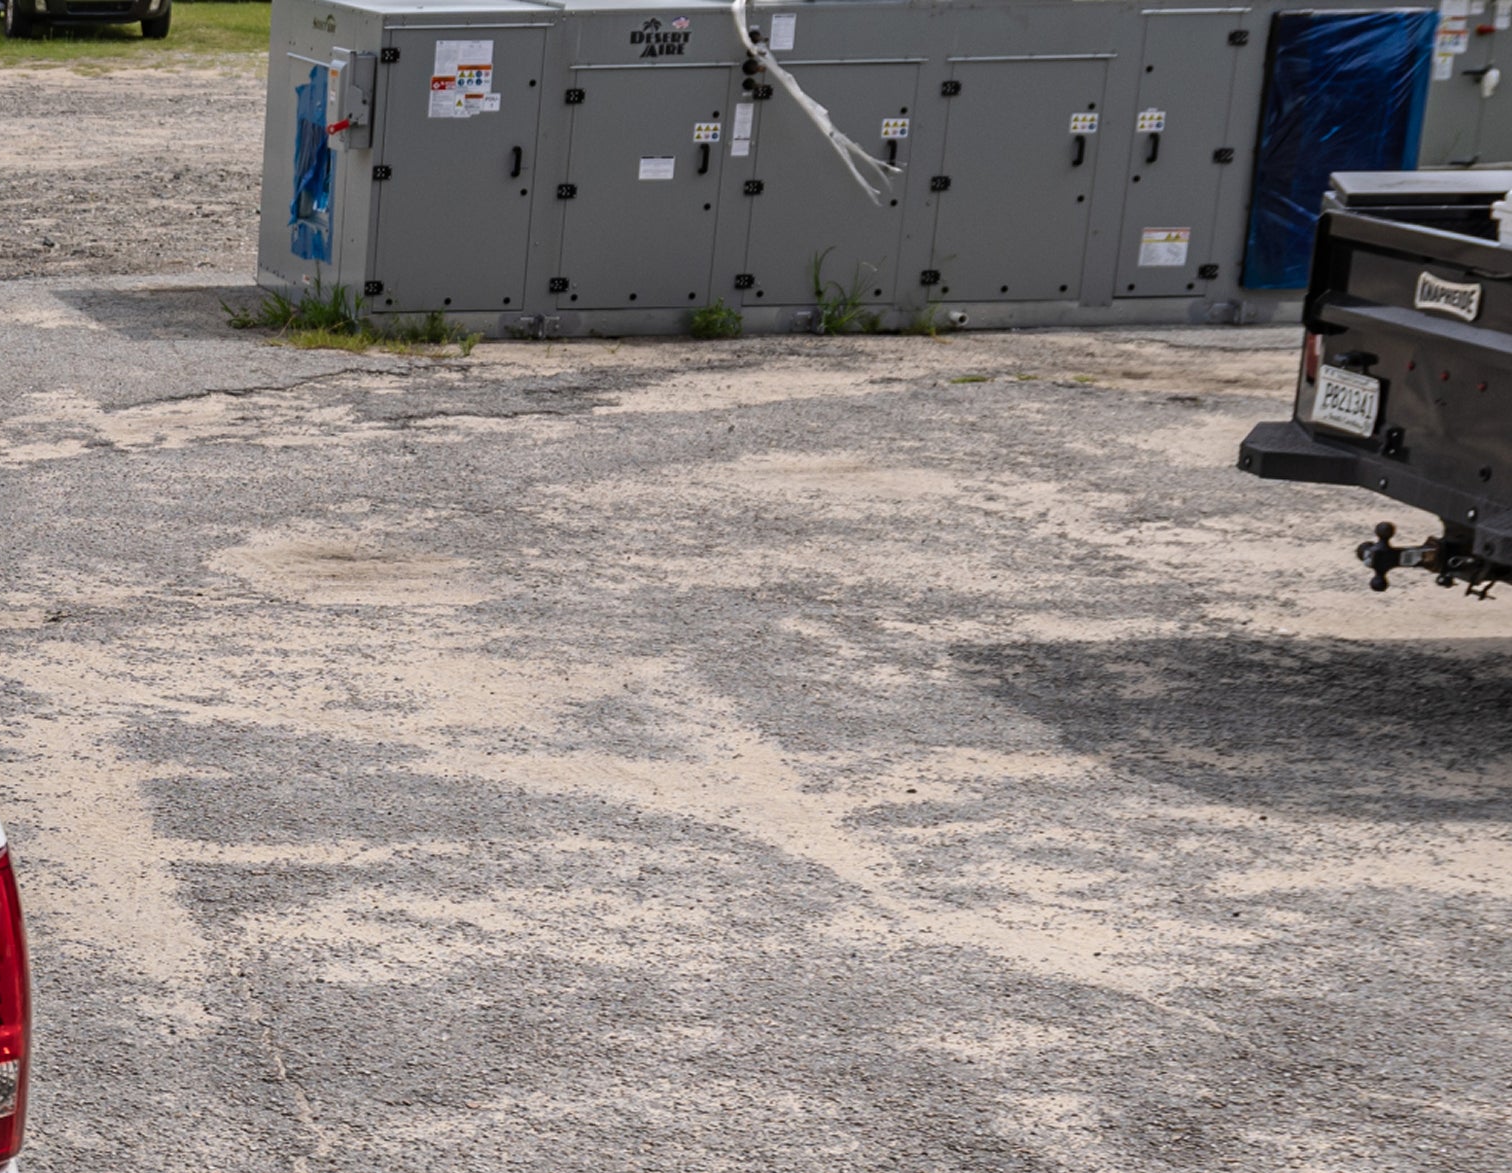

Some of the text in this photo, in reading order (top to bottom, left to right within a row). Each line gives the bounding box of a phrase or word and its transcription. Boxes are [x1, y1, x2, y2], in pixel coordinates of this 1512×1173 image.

[630, 31, 692, 44] DESERT
[639, 43, 685, 58] AIRE
[1420, 278, 1476, 313] KNAPHEIDE
